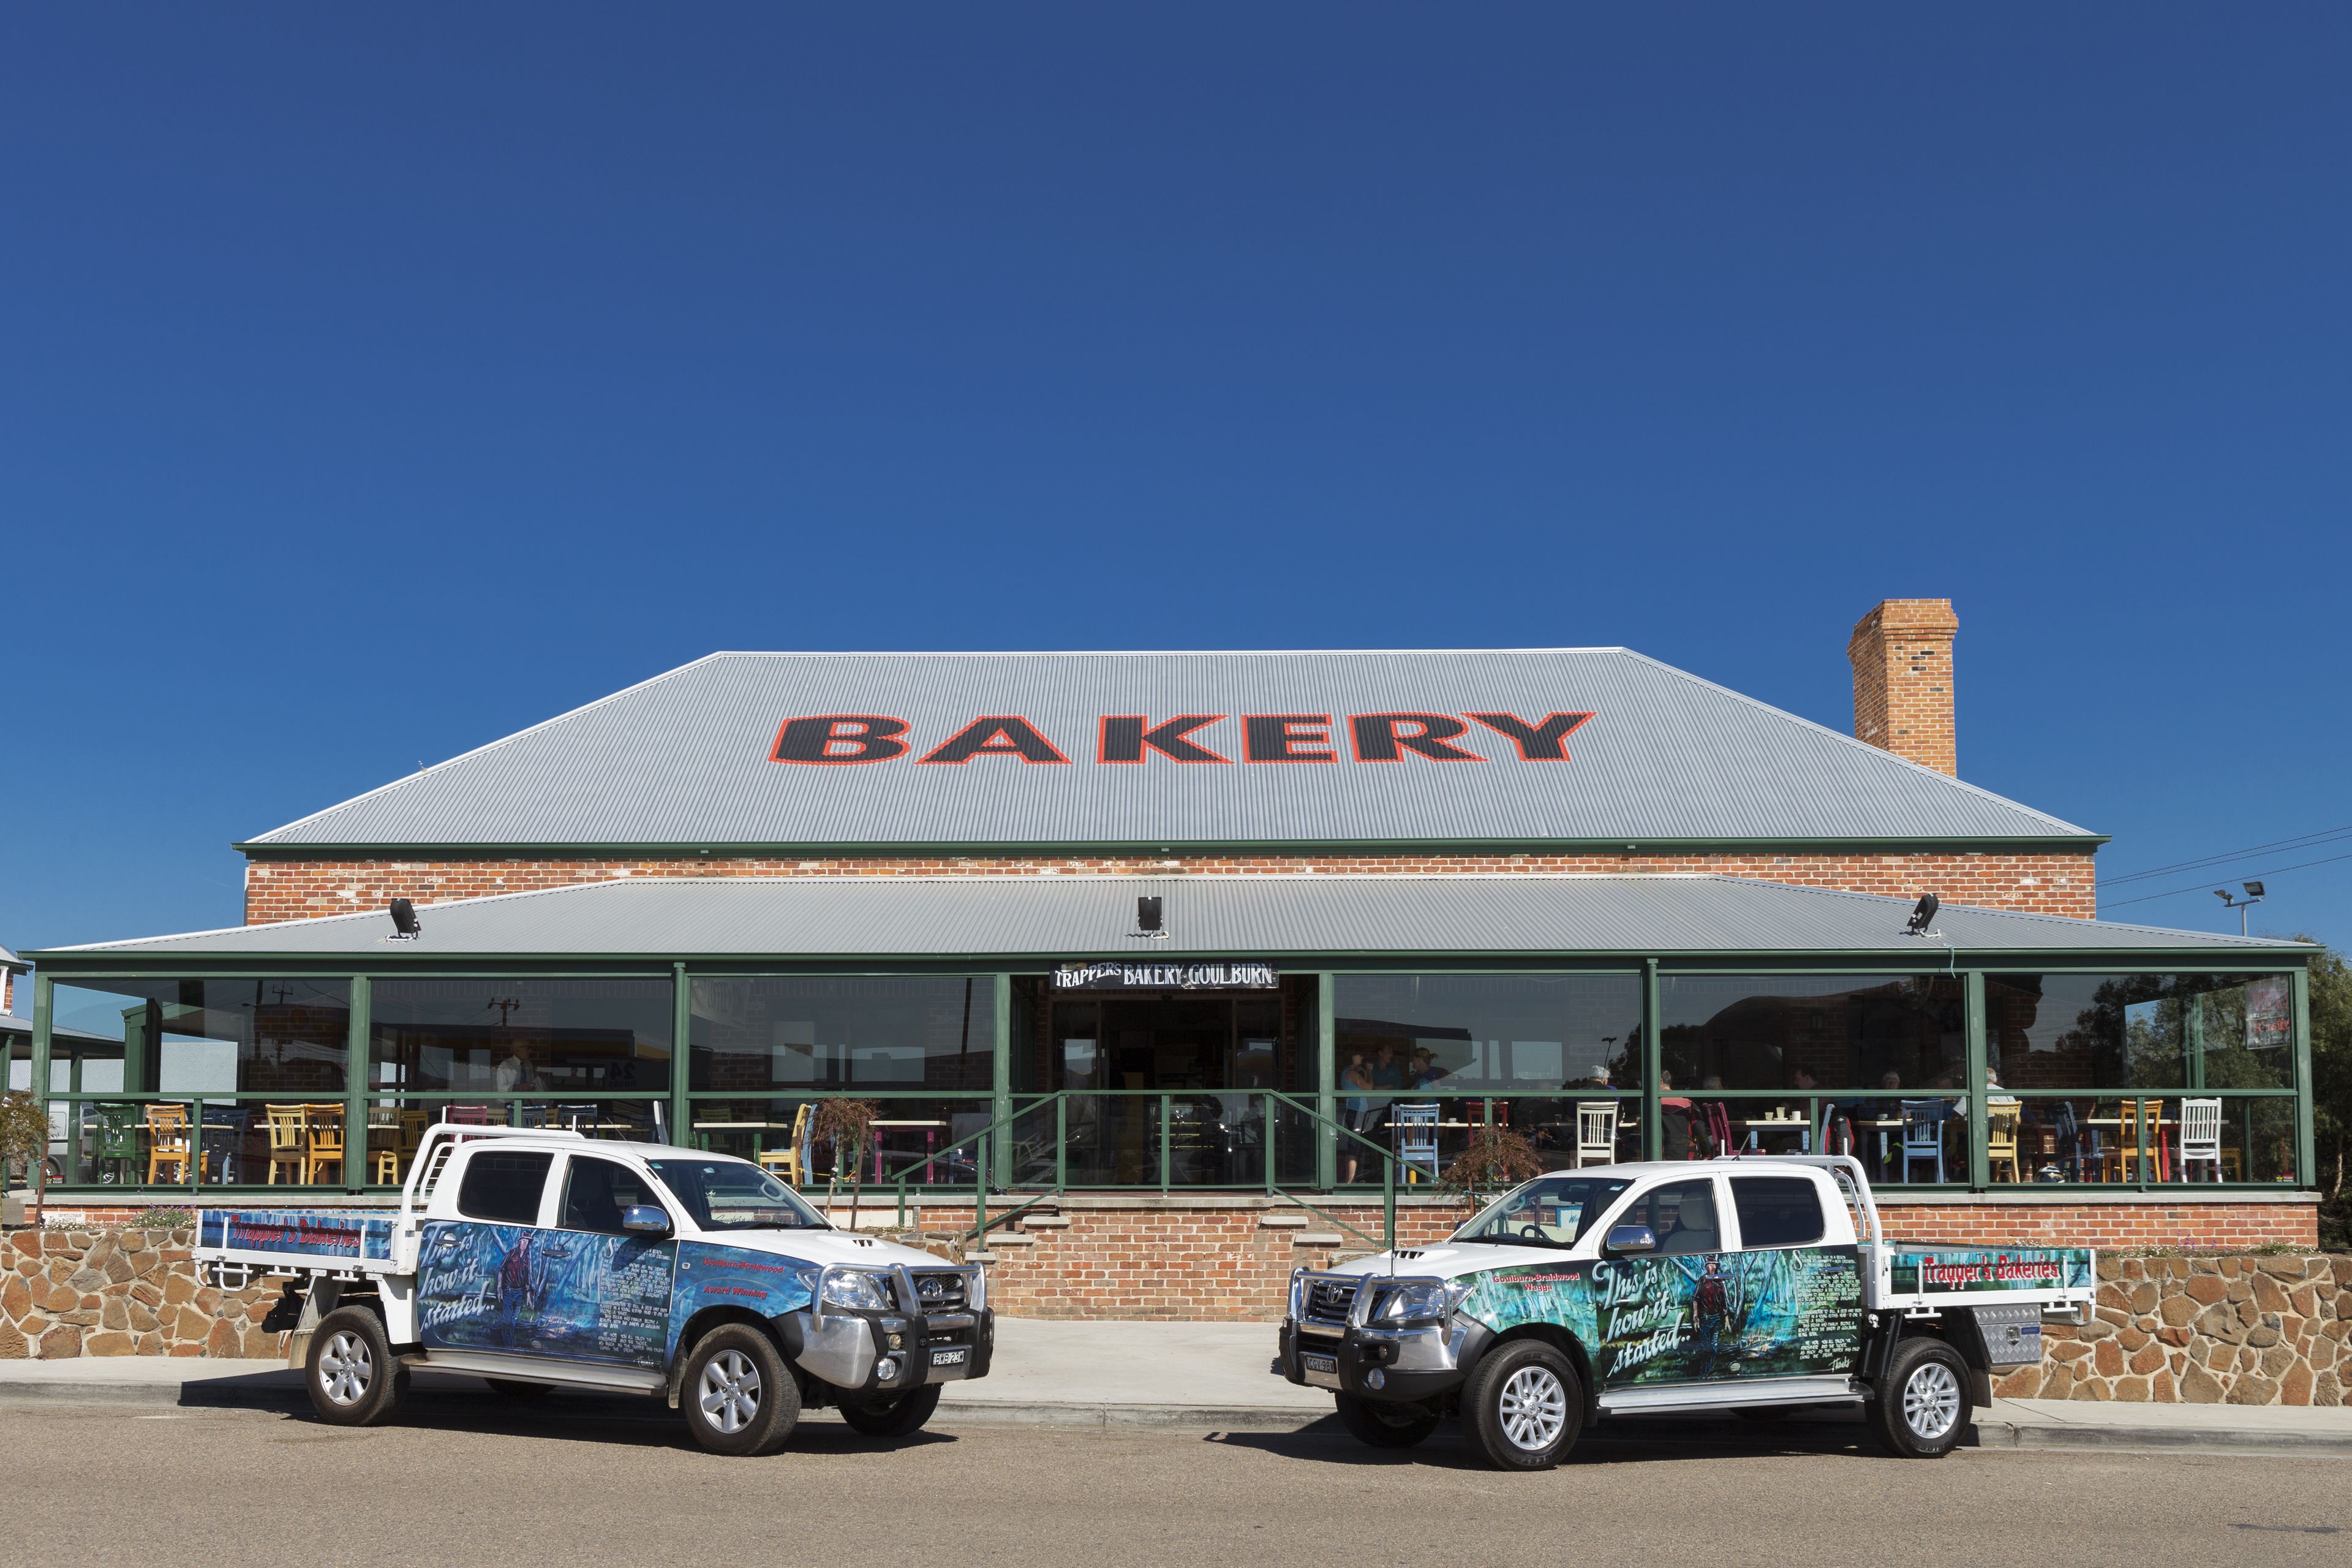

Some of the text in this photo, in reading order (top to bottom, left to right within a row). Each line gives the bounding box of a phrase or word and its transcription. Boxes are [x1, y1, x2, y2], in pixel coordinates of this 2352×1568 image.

[768, 711, 1596, 766] BAKERY
[1055, 962, 1272, 987] TRAPPER'S BAKERY GOULBURN
[230, 1214, 361, 1248] Trapper's Bakeries
[421, 1220, 475, 1268] This is
[418, 1258, 480, 1300] how it
[703, 1257, 784, 1273] Goulburn-Braidwood
[1493, 1272, 1580, 1283] Goulburn-Braidwood
[1924, 1254, 2061, 1289] Trapper's Bakeries
[703, 1284, 767, 1300] Award Winning
[1524, 1283, 1553, 1293] Wagga
[1592, 1261, 1659, 1310] This is
[420, 1281, 495, 1333] started..
[1607, 1290, 1671, 1343] how it
[1607, 1311, 1691, 1378] started..
[1828, 1356, 1853, 1372] Thanks
